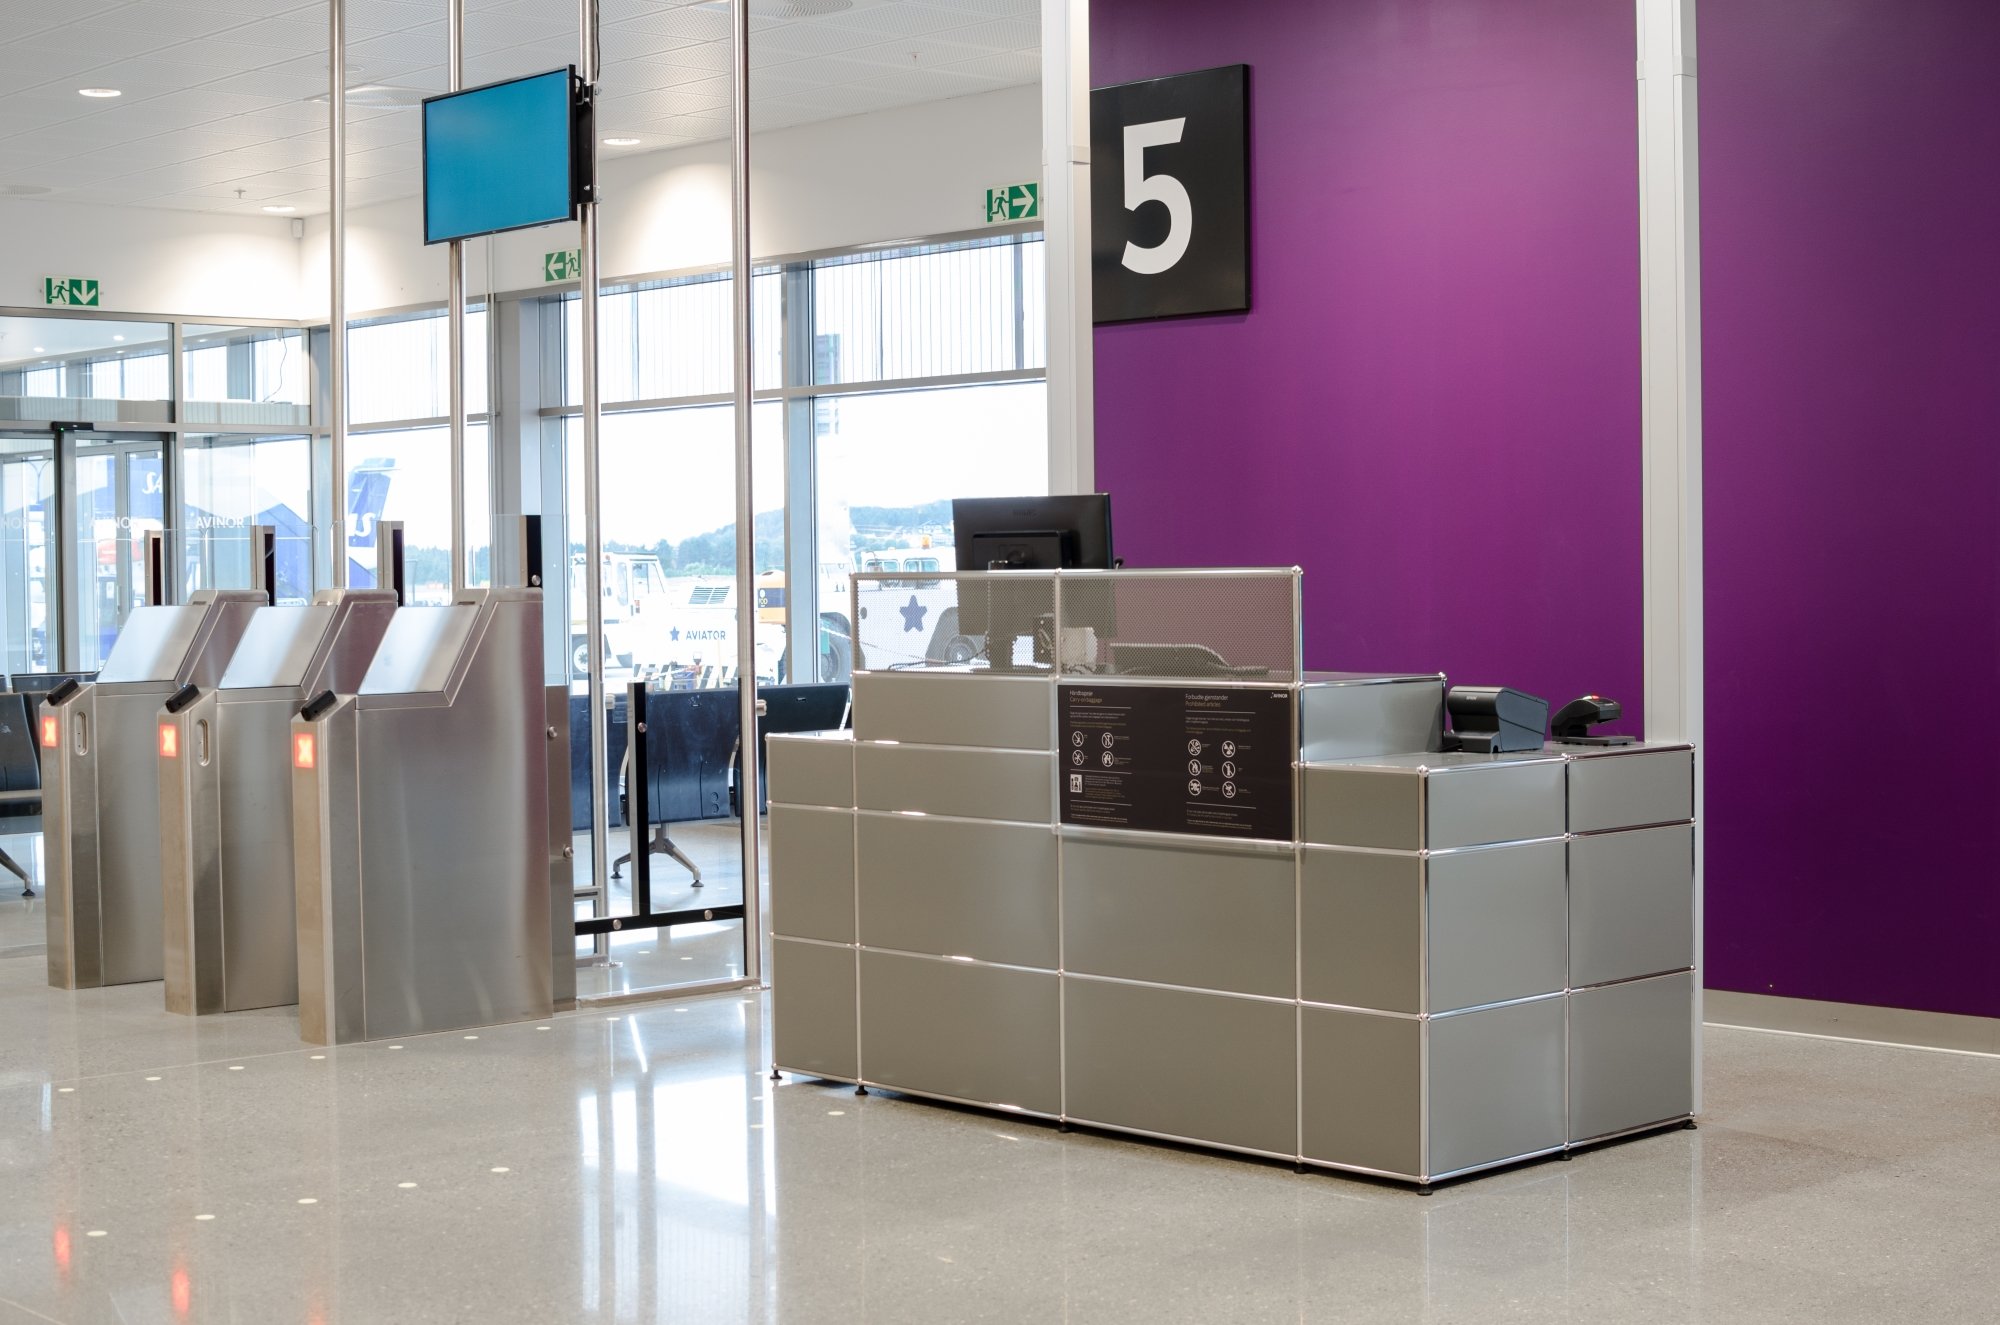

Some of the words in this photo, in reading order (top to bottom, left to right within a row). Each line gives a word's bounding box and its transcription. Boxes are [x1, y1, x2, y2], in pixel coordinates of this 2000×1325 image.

[1121, 117, 1193, 275] 5
[195, 516, 245, 529] AVINOR
[686, 630, 726, 640] AVIATOR
